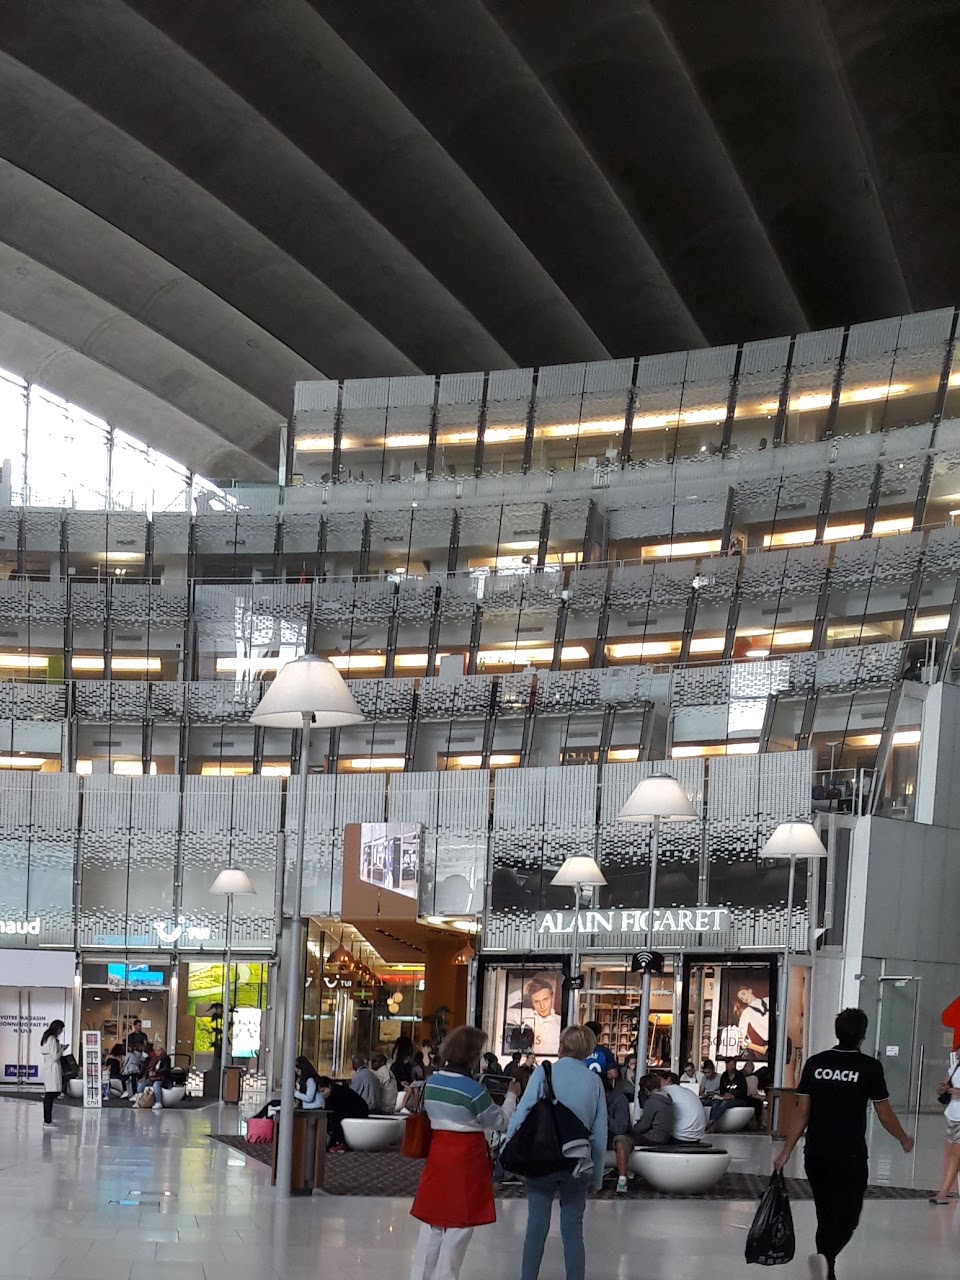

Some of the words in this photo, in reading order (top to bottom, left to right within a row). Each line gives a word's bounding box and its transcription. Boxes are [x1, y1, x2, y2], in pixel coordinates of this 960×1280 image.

[538, 912, 613, 933] ALAIN
[620, 909, 728, 932] FIGARET
[186, 926, 210, 940] TUI
[708, 1036, 750, 1048] SOLDES
[814, 1067, 860, 1083] COACH
